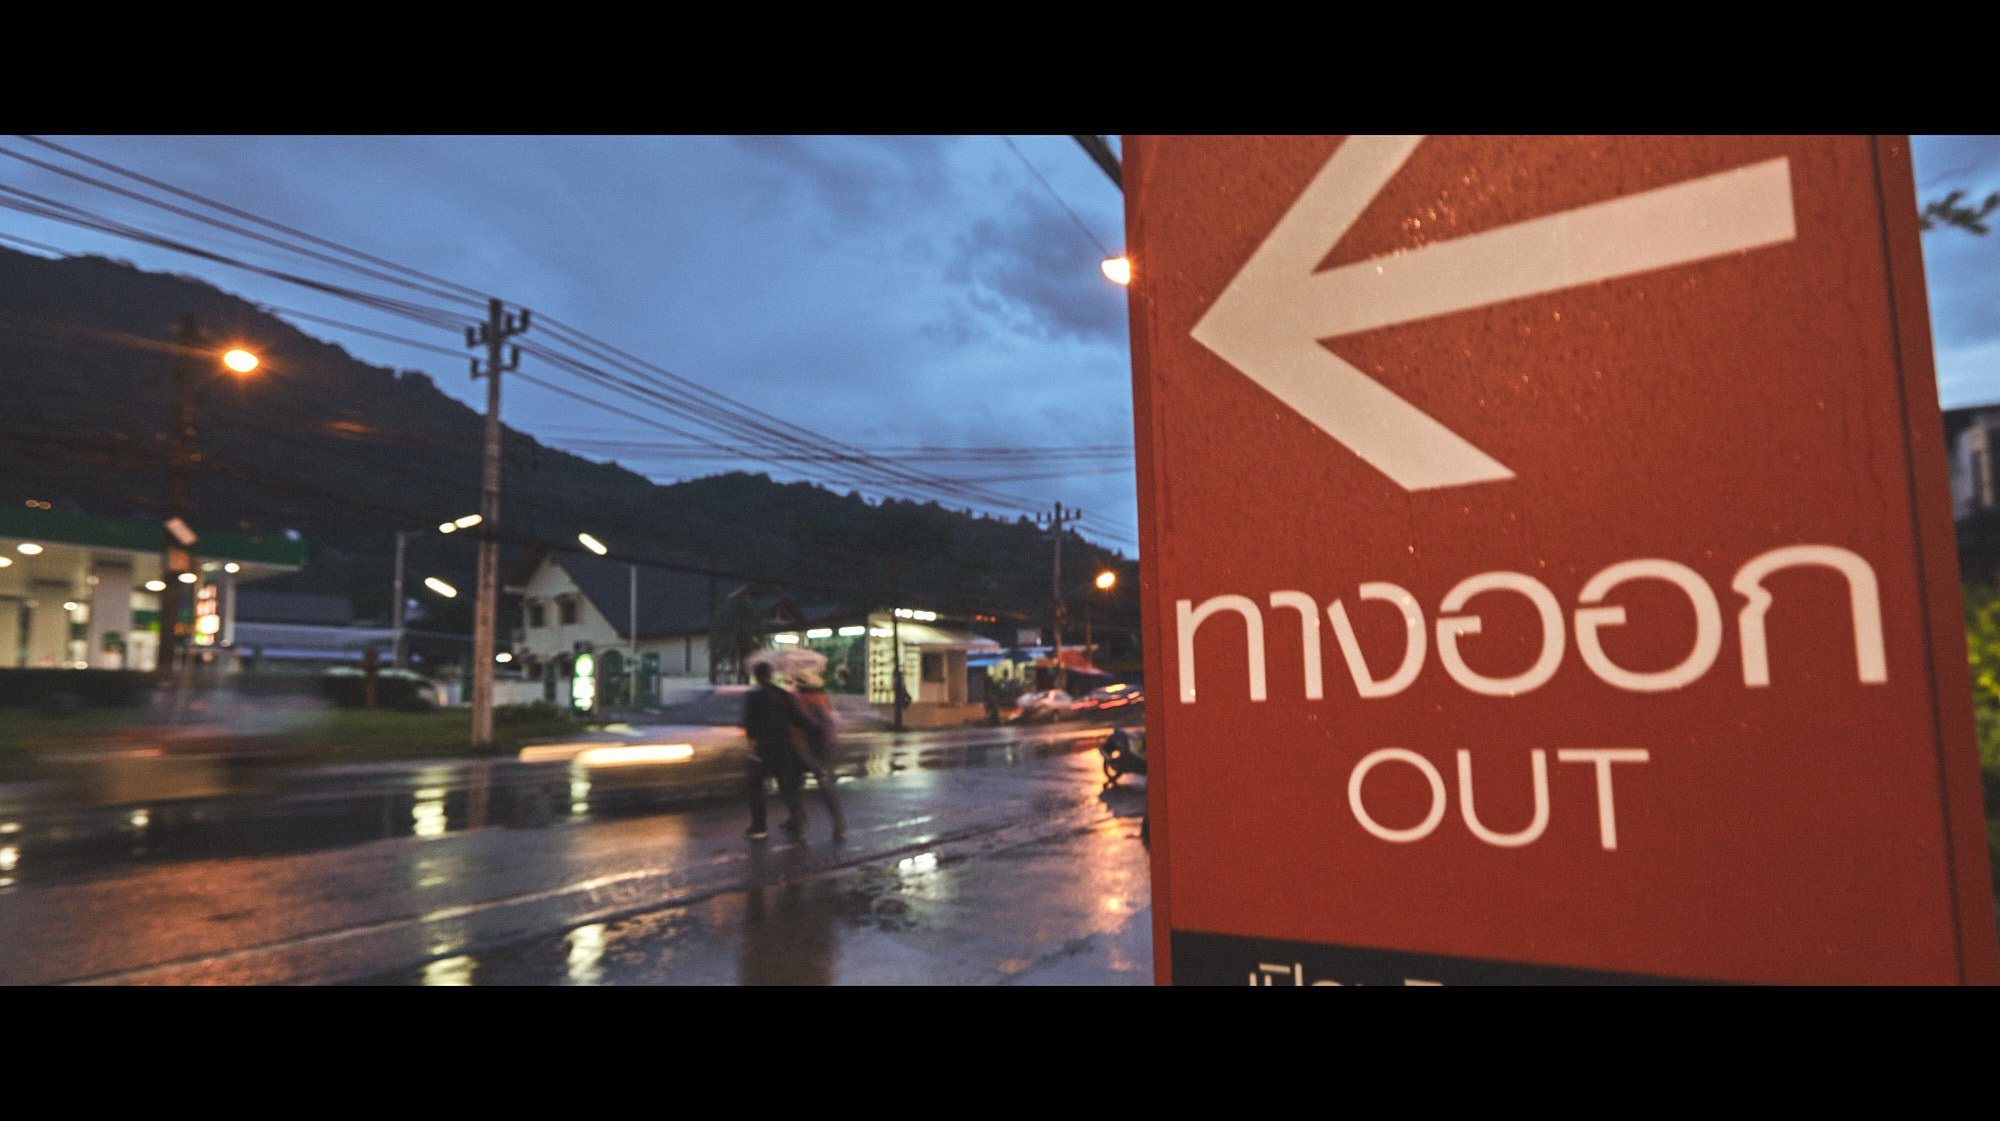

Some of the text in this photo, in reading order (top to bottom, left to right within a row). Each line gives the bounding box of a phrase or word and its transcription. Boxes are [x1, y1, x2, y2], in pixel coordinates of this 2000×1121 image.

[1176, 545, 1887, 703] ทางออก
[1348, 748, 1649, 849] OUT
